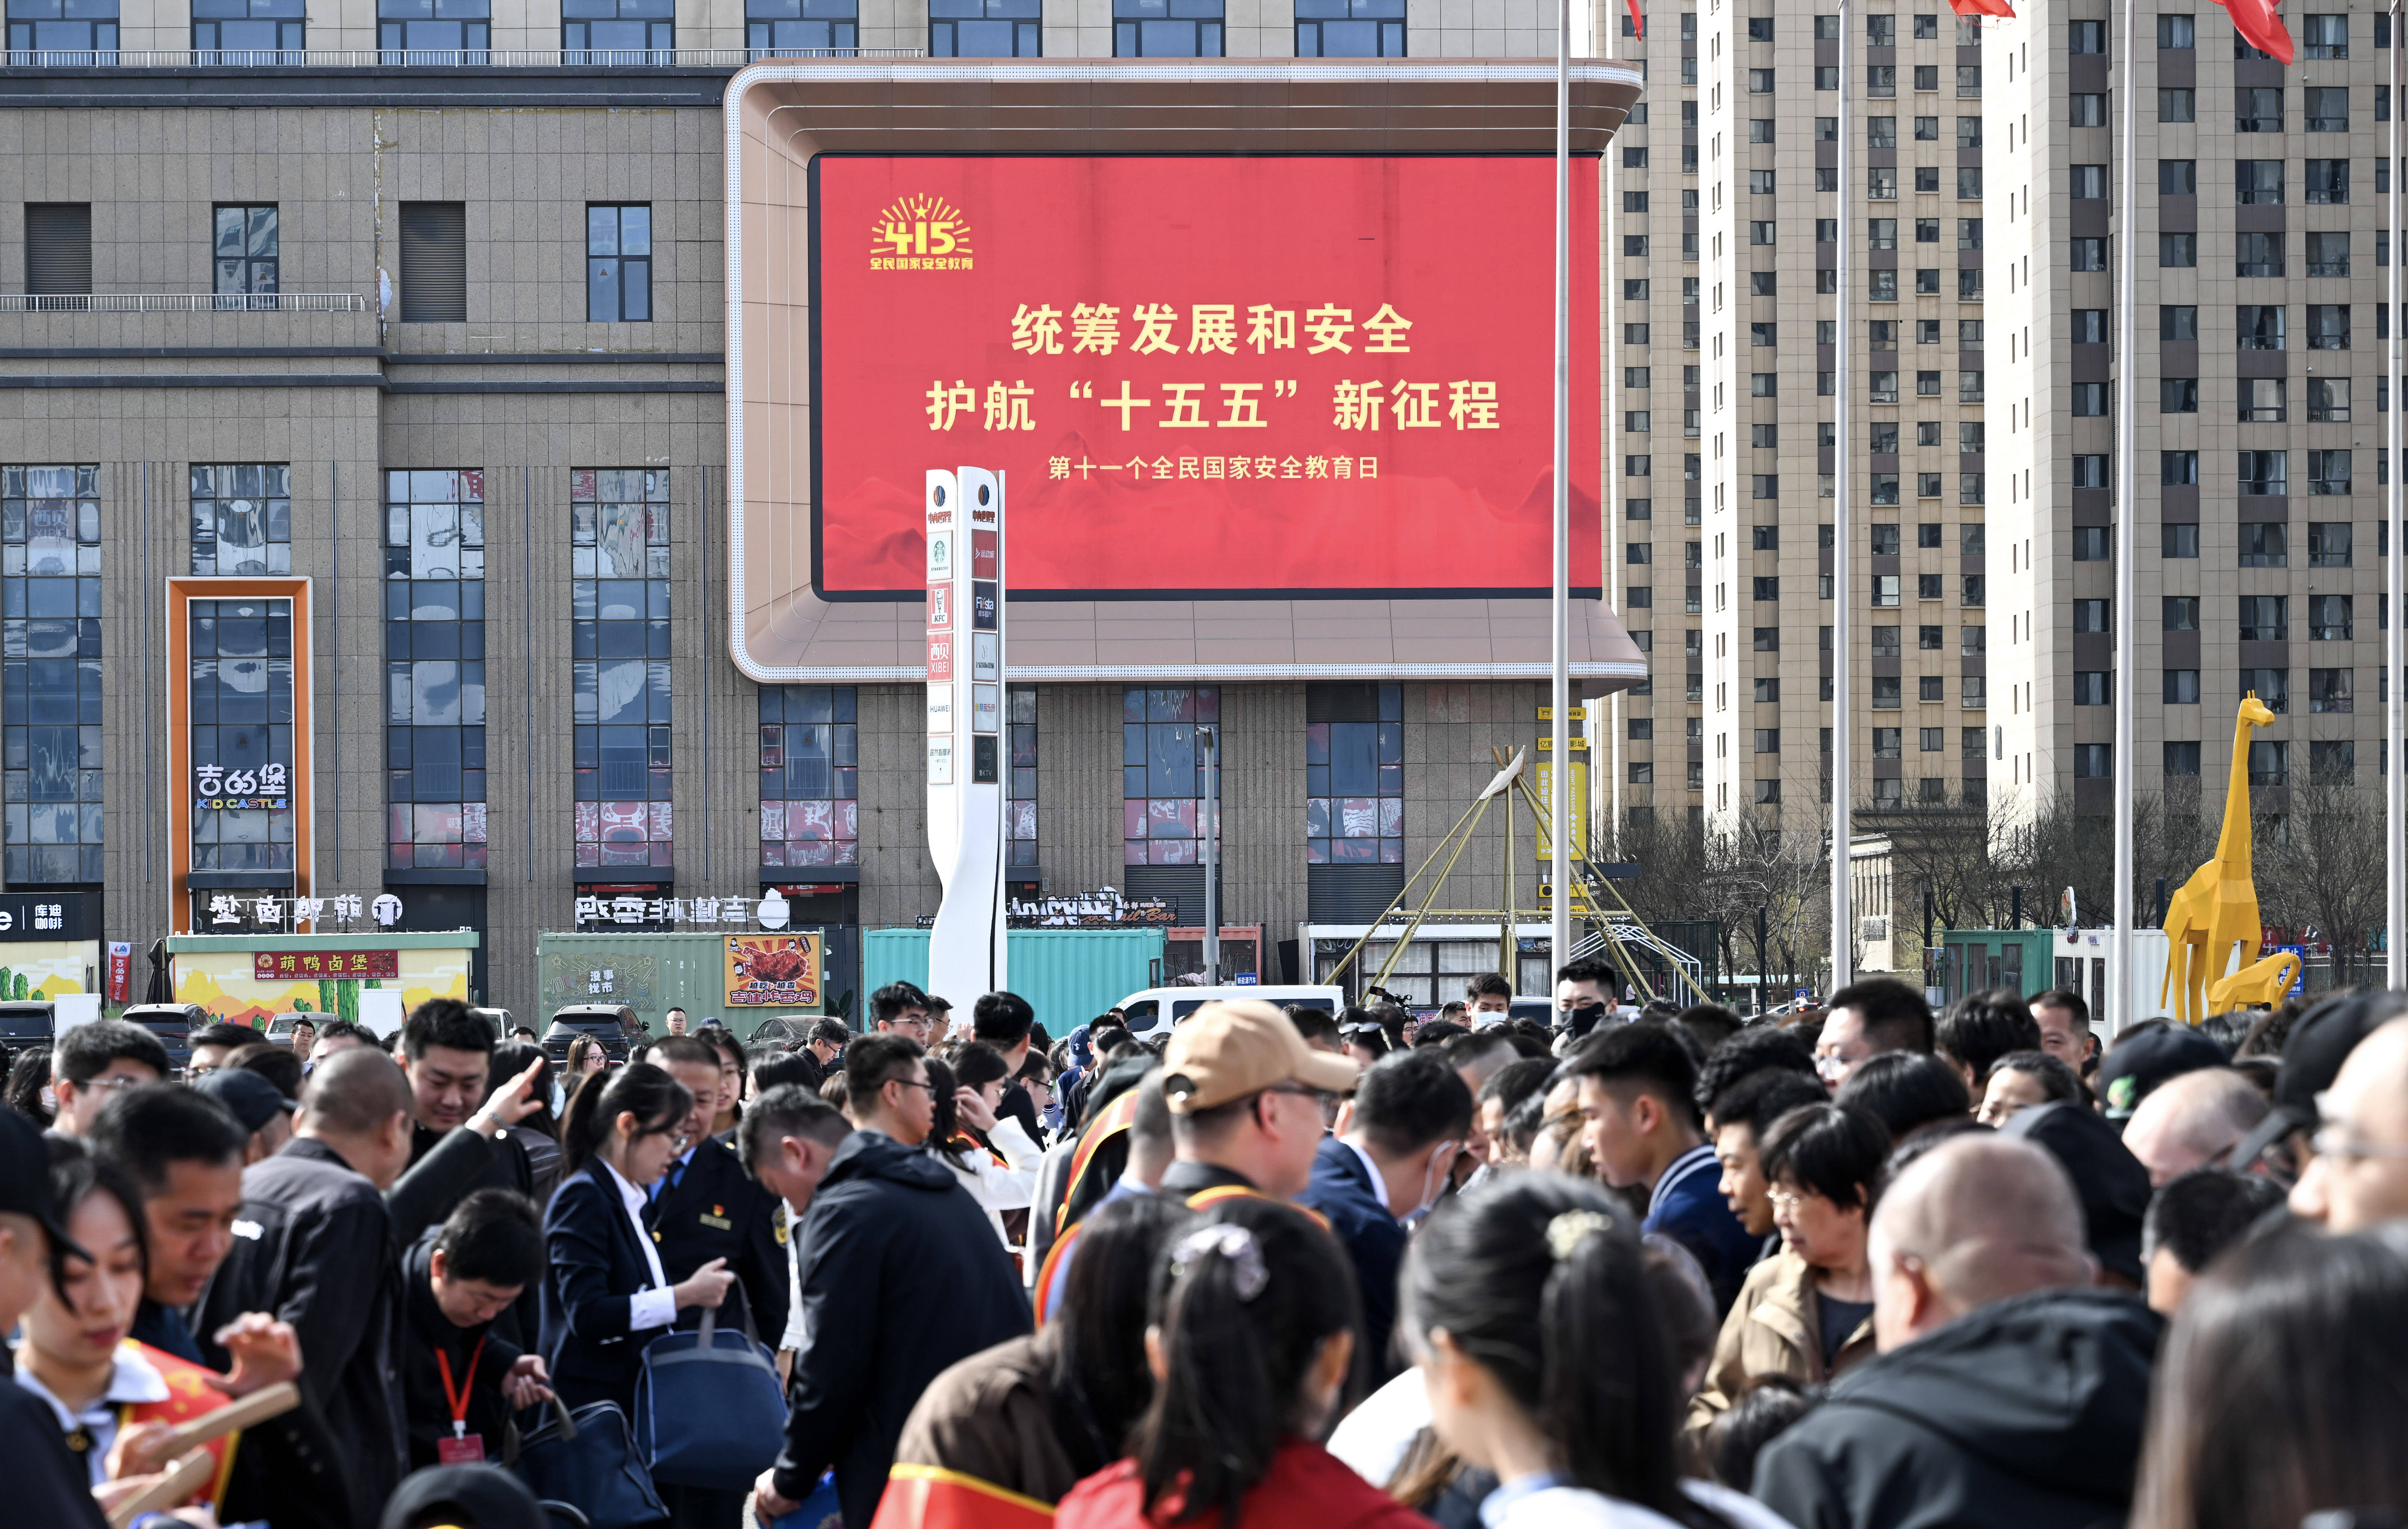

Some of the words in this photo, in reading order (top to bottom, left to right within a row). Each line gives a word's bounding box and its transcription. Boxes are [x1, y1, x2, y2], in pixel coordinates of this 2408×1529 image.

[885, 222, 956, 255] 415
[870, 257, 973, 270] 全民国家安全教育
[1011, 302, 1414, 356] 统筹发展和安全
[1049, 455, 1378, 481] 第十一个全民国家安全教育日
[928, 511, 952, 524] 中商世界里
[931, 662, 949, 674] XIBEI
[197, 799, 223, 809] KID
[226, 798, 287, 809] CASTLE
[35, 904, 62, 917] 库迪
[1145, 908, 1177, 921] Bar
[35, 917, 63, 930] 咖啡
[280, 954, 368, 972] 萌鸭卤堡
[590, 969, 614, 982] 没事
[588, 982, 613, 994] 找市
[731, 991, 813, 1003] 吉健炸香鸡
